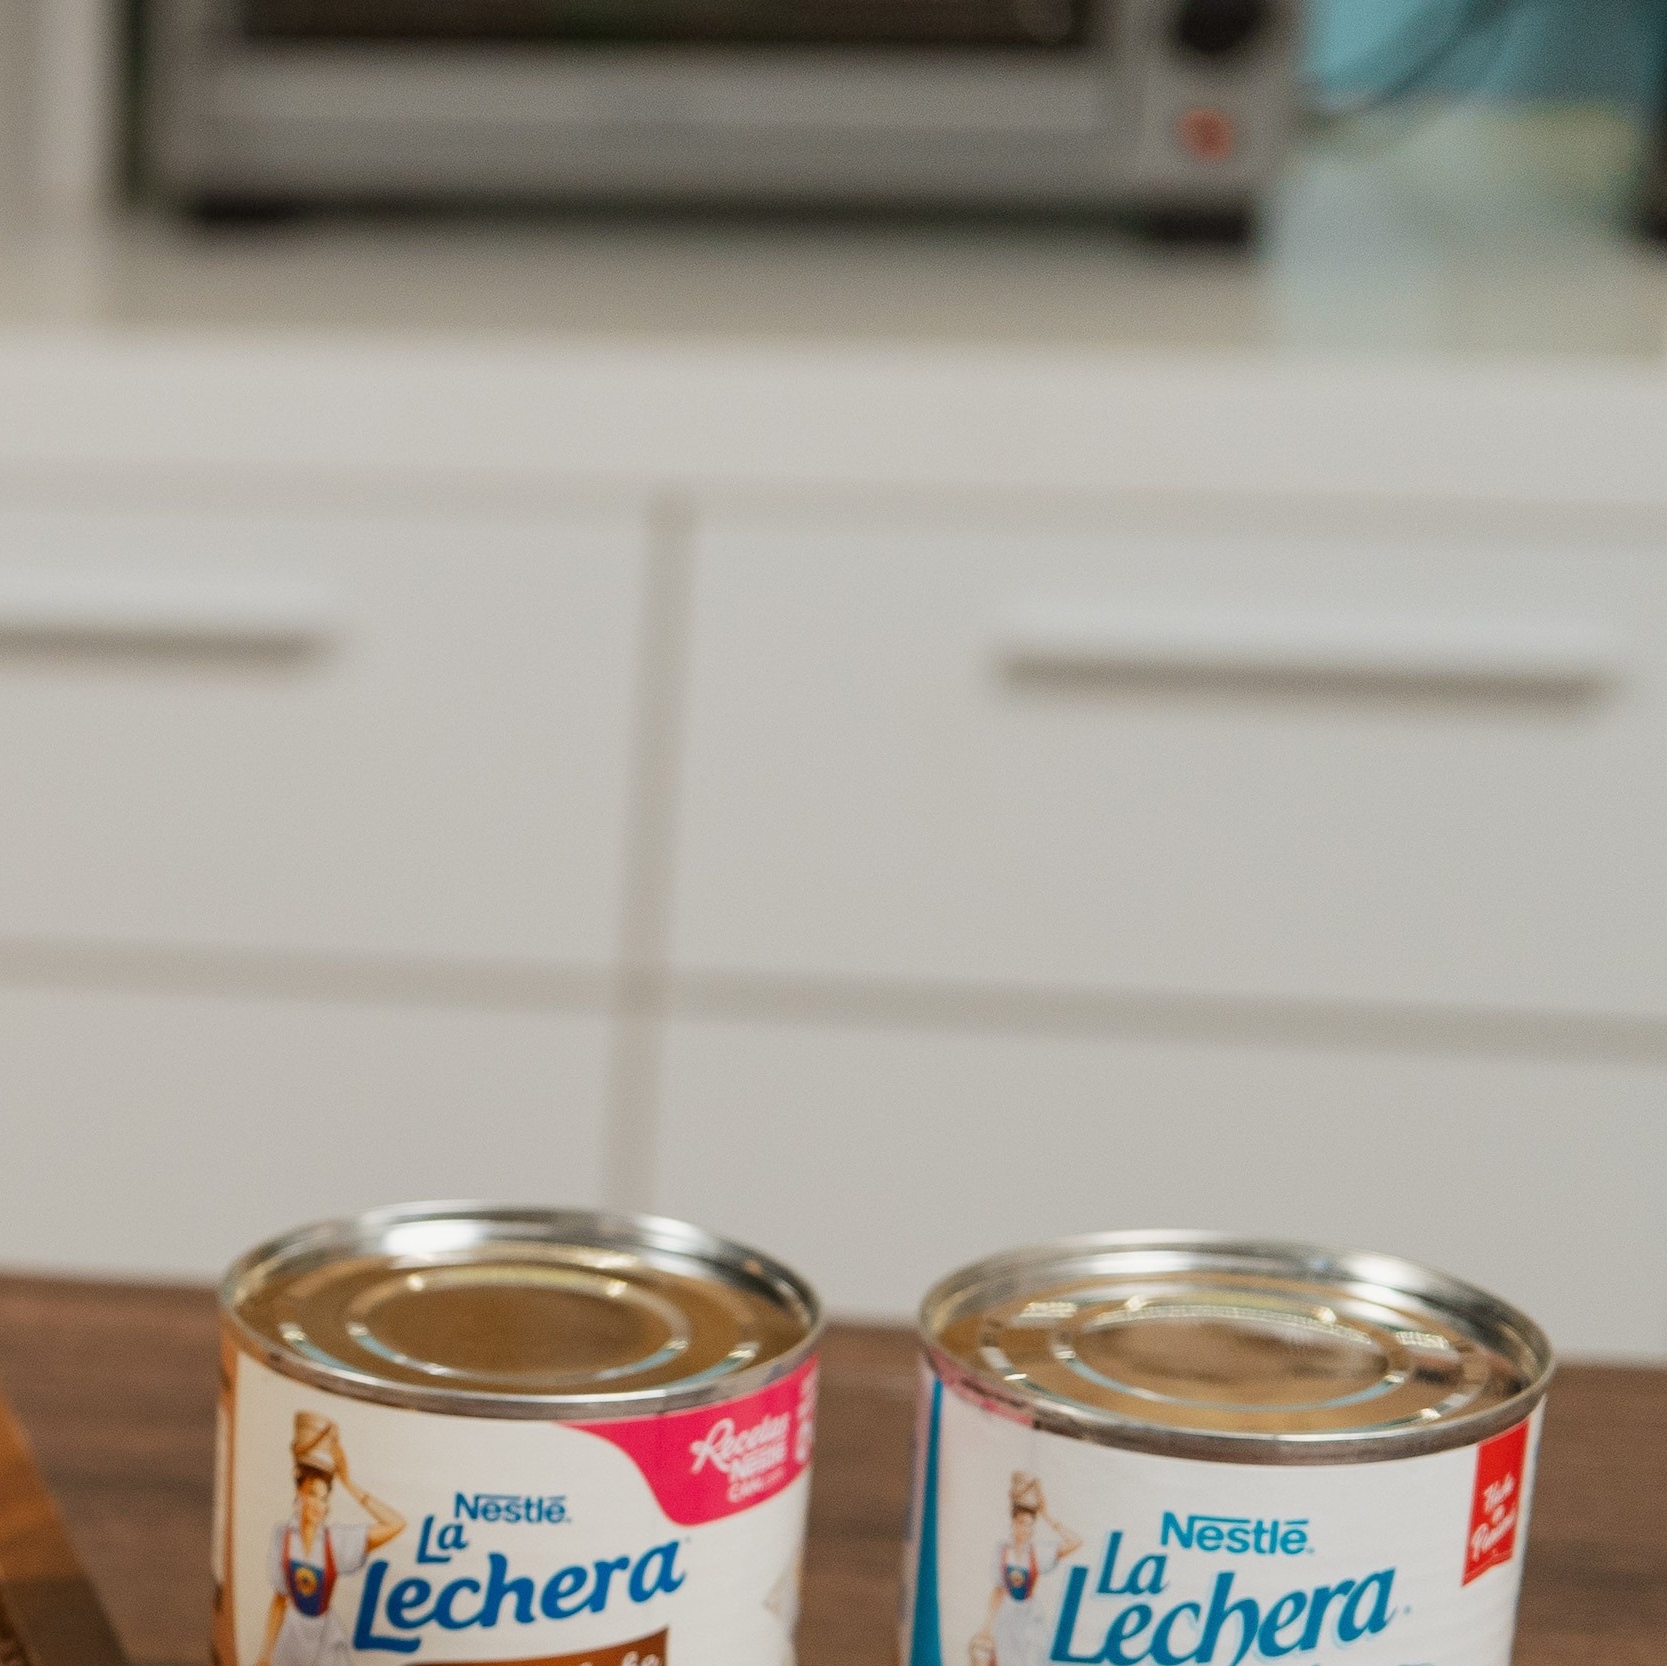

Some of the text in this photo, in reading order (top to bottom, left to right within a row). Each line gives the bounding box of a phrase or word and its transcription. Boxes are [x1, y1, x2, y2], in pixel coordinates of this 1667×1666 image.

[454, 1492, 567, 1524] Nestlé
[416, 1515, 469, 1564] La
[1160, 1511, 1309, 1555] Nestlé
[1095, 1531, 1169, 1595] La
[353, 1540, 687, 1654] Lechera
